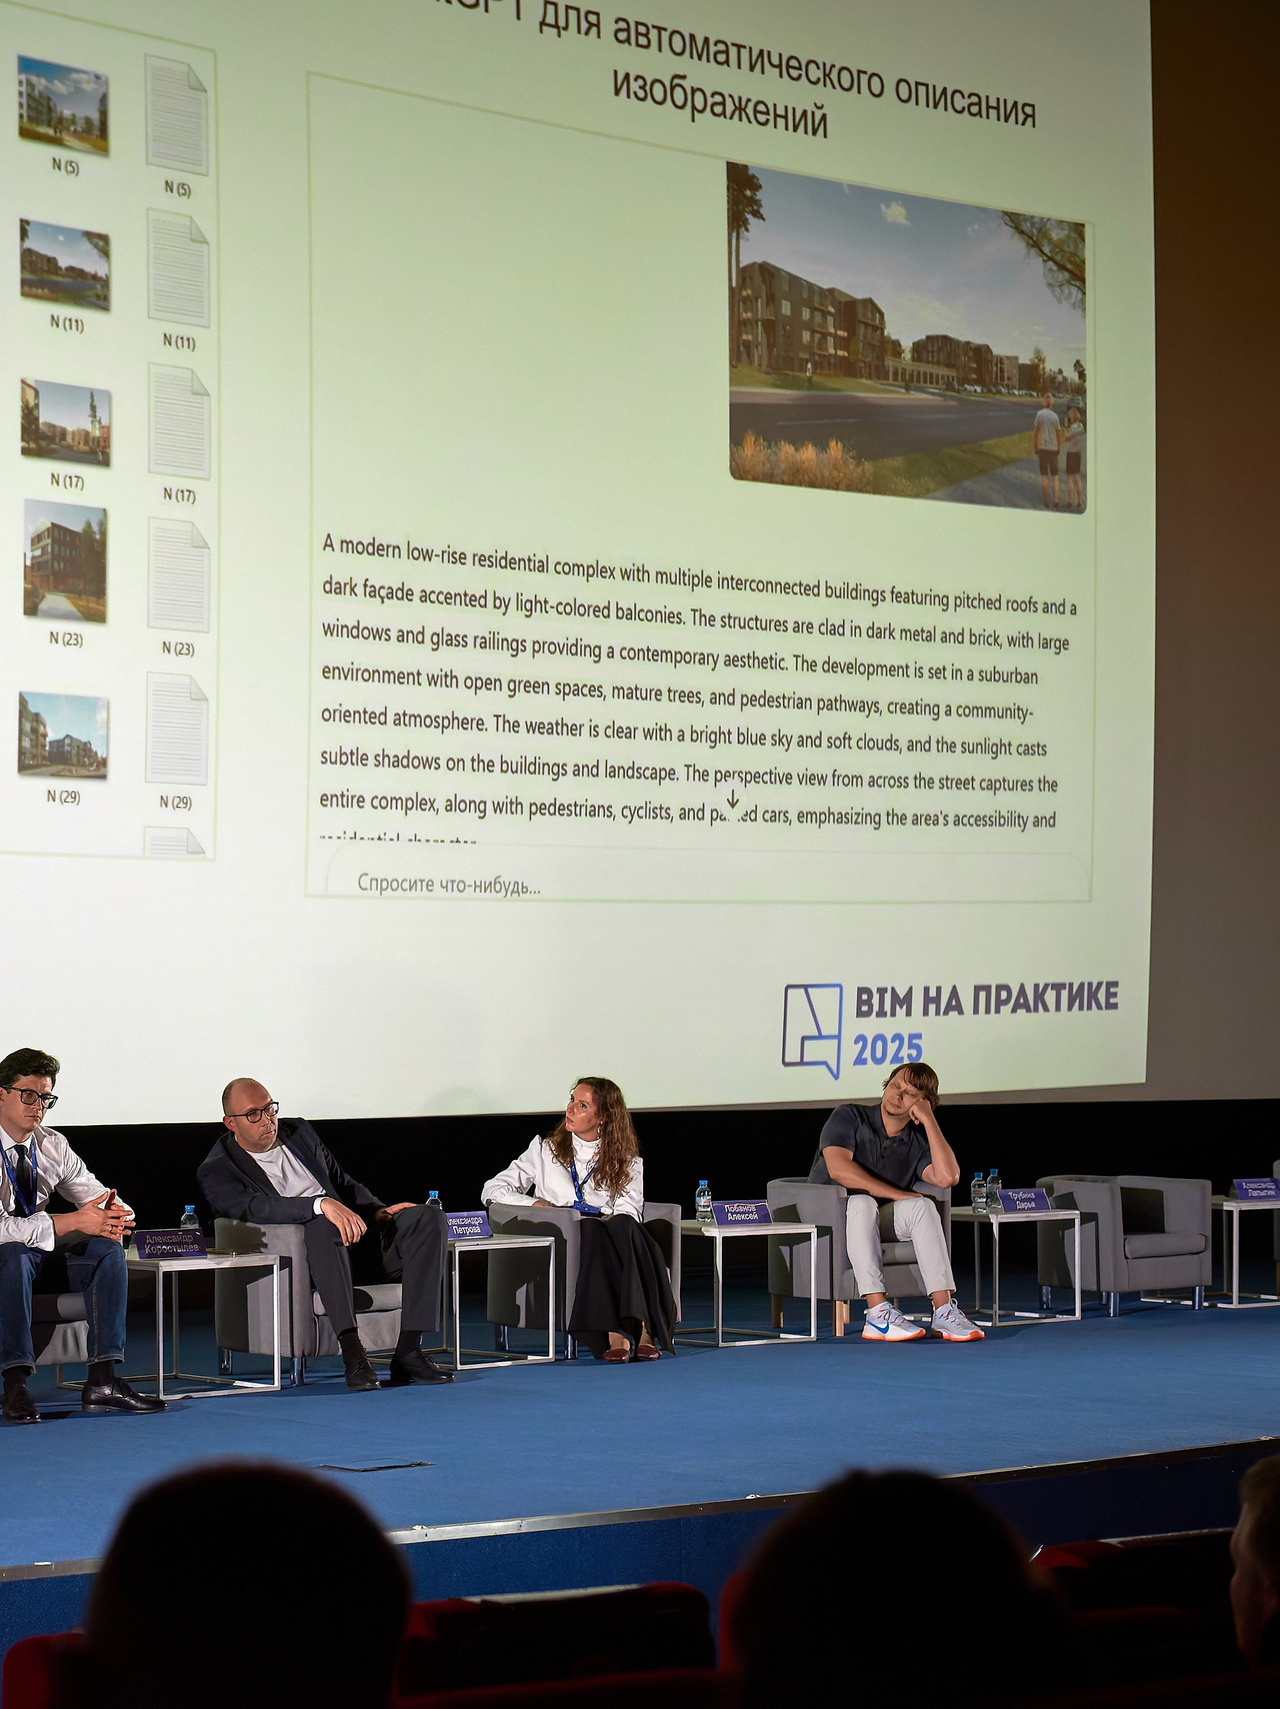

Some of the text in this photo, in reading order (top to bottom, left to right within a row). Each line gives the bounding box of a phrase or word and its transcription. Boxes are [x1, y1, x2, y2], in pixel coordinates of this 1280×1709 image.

[539, 0, 601, 39] для
[613, 15, 885, 98] автоматического
[895, 77, 1037, 128] описания
[613, 68, 829, 138] изображений
[164, 179, 191, 199] N (5)
[323, 533, 1077, 615] A modern low-rise residential complex with multiple interconnected buildings featuring pitched roofs and a
[323, 574, 1069, 655] dark façade accented by light-colored balconies. The structures are clad in dark metal and brick, with large
[322, 618, 1038, 685] windows and glass railings providing a contemporary aesthetic. The development is set in a suburban
[322, 661, 1033, 725] environment with open green spaces, mature trees, and pedestrian pathways, creating a community-
[321, 703, 1047, 760] oriented atmosphere. The weather is clear with a bright blue sky and soft clouds, and the sunlight casts
[321, 745, 1058, 796] subtle shadows on the buildings and landscape. The perspective view from across the street captures the
[47, 789, 80, 806] N (29)
[320, 788, 1056, 833] entire complex, along with pedestrians, cyclists, and paed cars, emphasizing the area's accessibility and
[358, 872, 542, 898] Спросите что-нибудь...
[855, 980, 1120, 1018] BIM НА ПРАКТИКЕ
[853, 1032, 923, 1067] 2025
[453, 1225, 481, 1235] Петрова
[727, 1212, 759, 1221] Алексей
[145, 1244, 200, 1255] Коростылев
[146, 1234, 194, 1244] Александр
